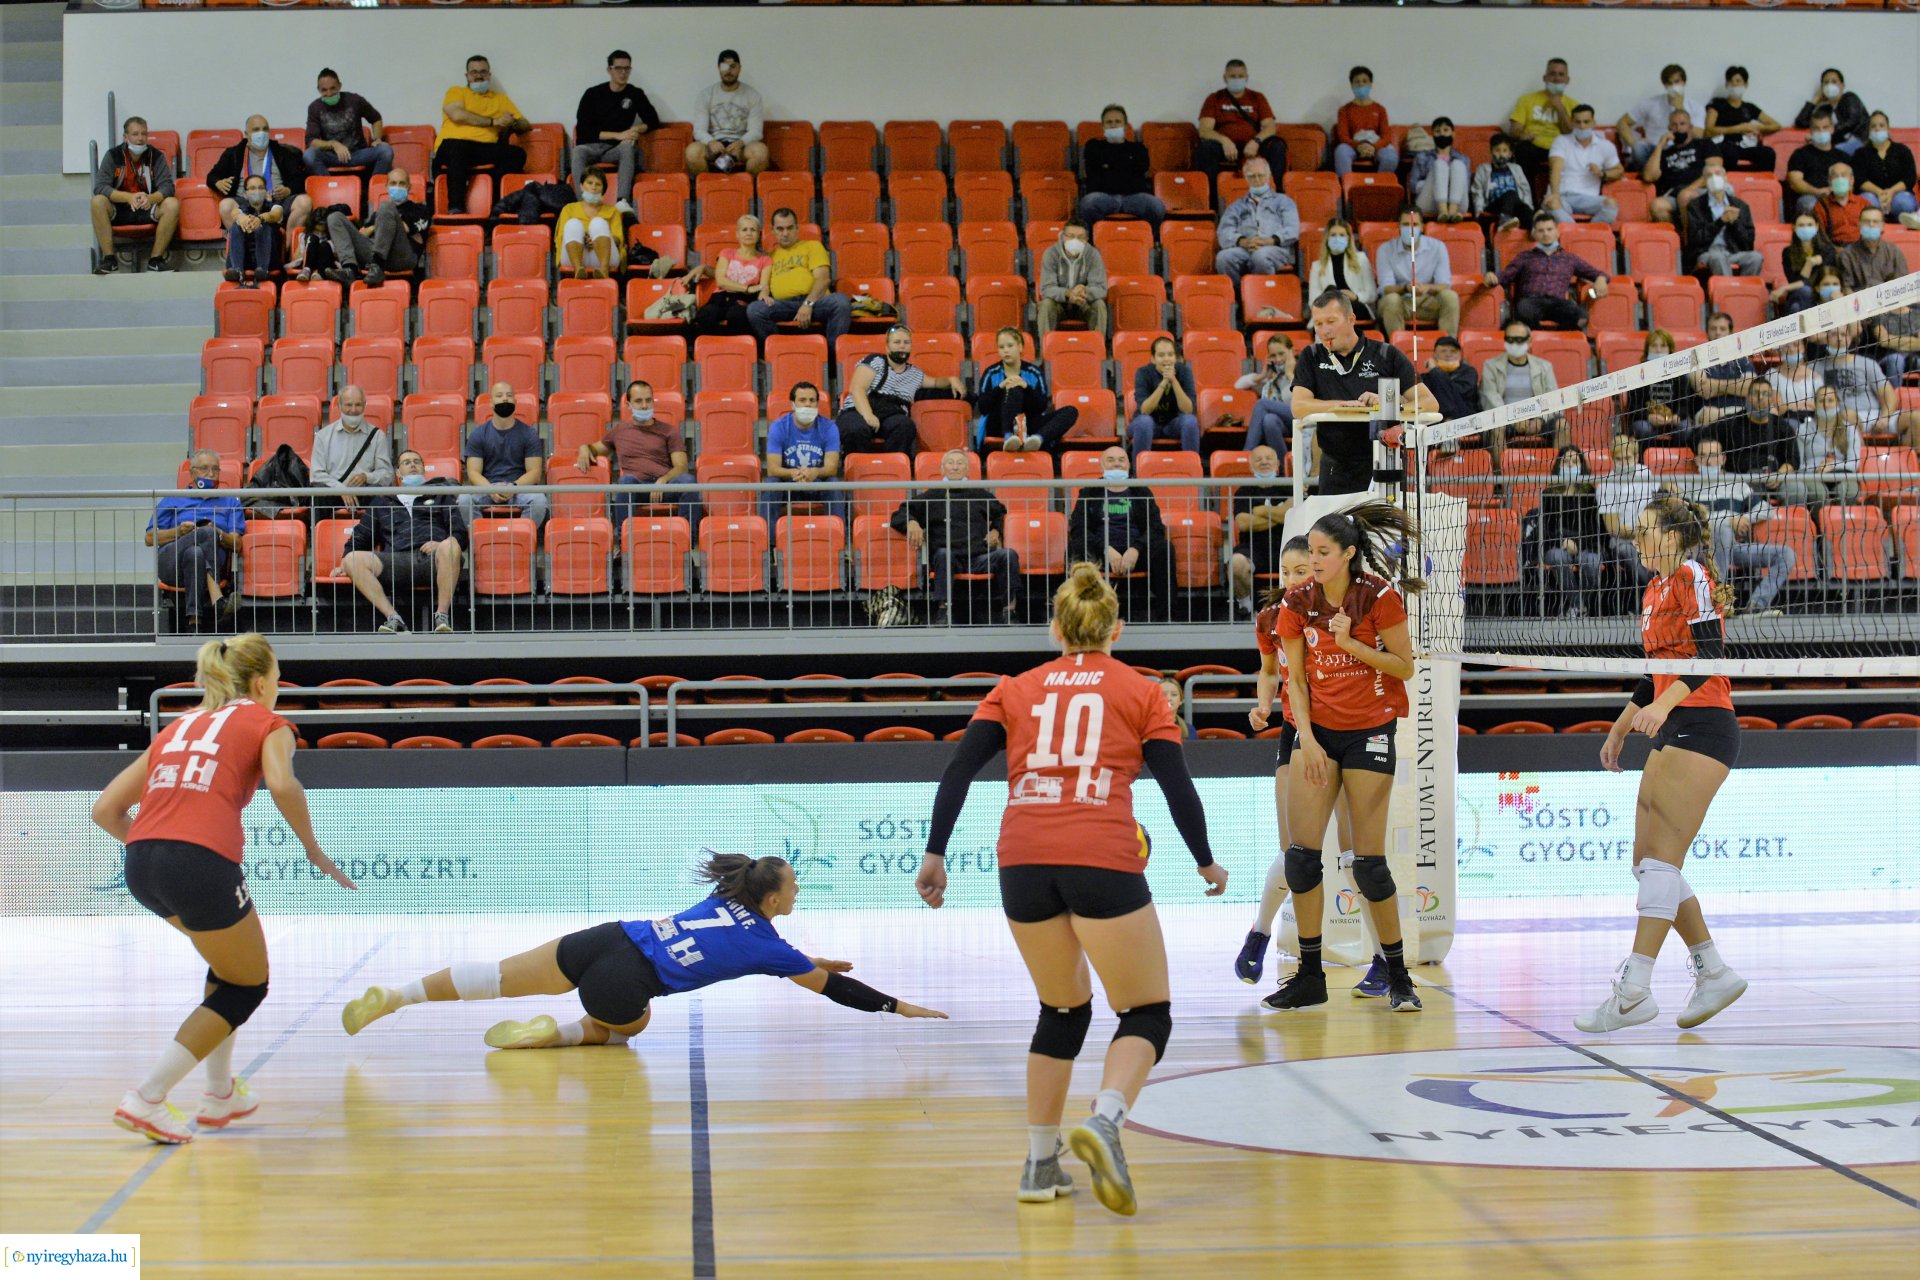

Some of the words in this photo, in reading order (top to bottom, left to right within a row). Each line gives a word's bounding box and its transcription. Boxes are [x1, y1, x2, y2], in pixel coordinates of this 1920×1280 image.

[1043, 671, 1104, 686] NAJDIC
[160, 706, 238, 755] 11
[1026, 692, 1104, 769] 10
[1738, 836, 1794, 858] ZRT.
[420, 857, 478, 880] ZRT.
[678, 907, 736, 930] 7
